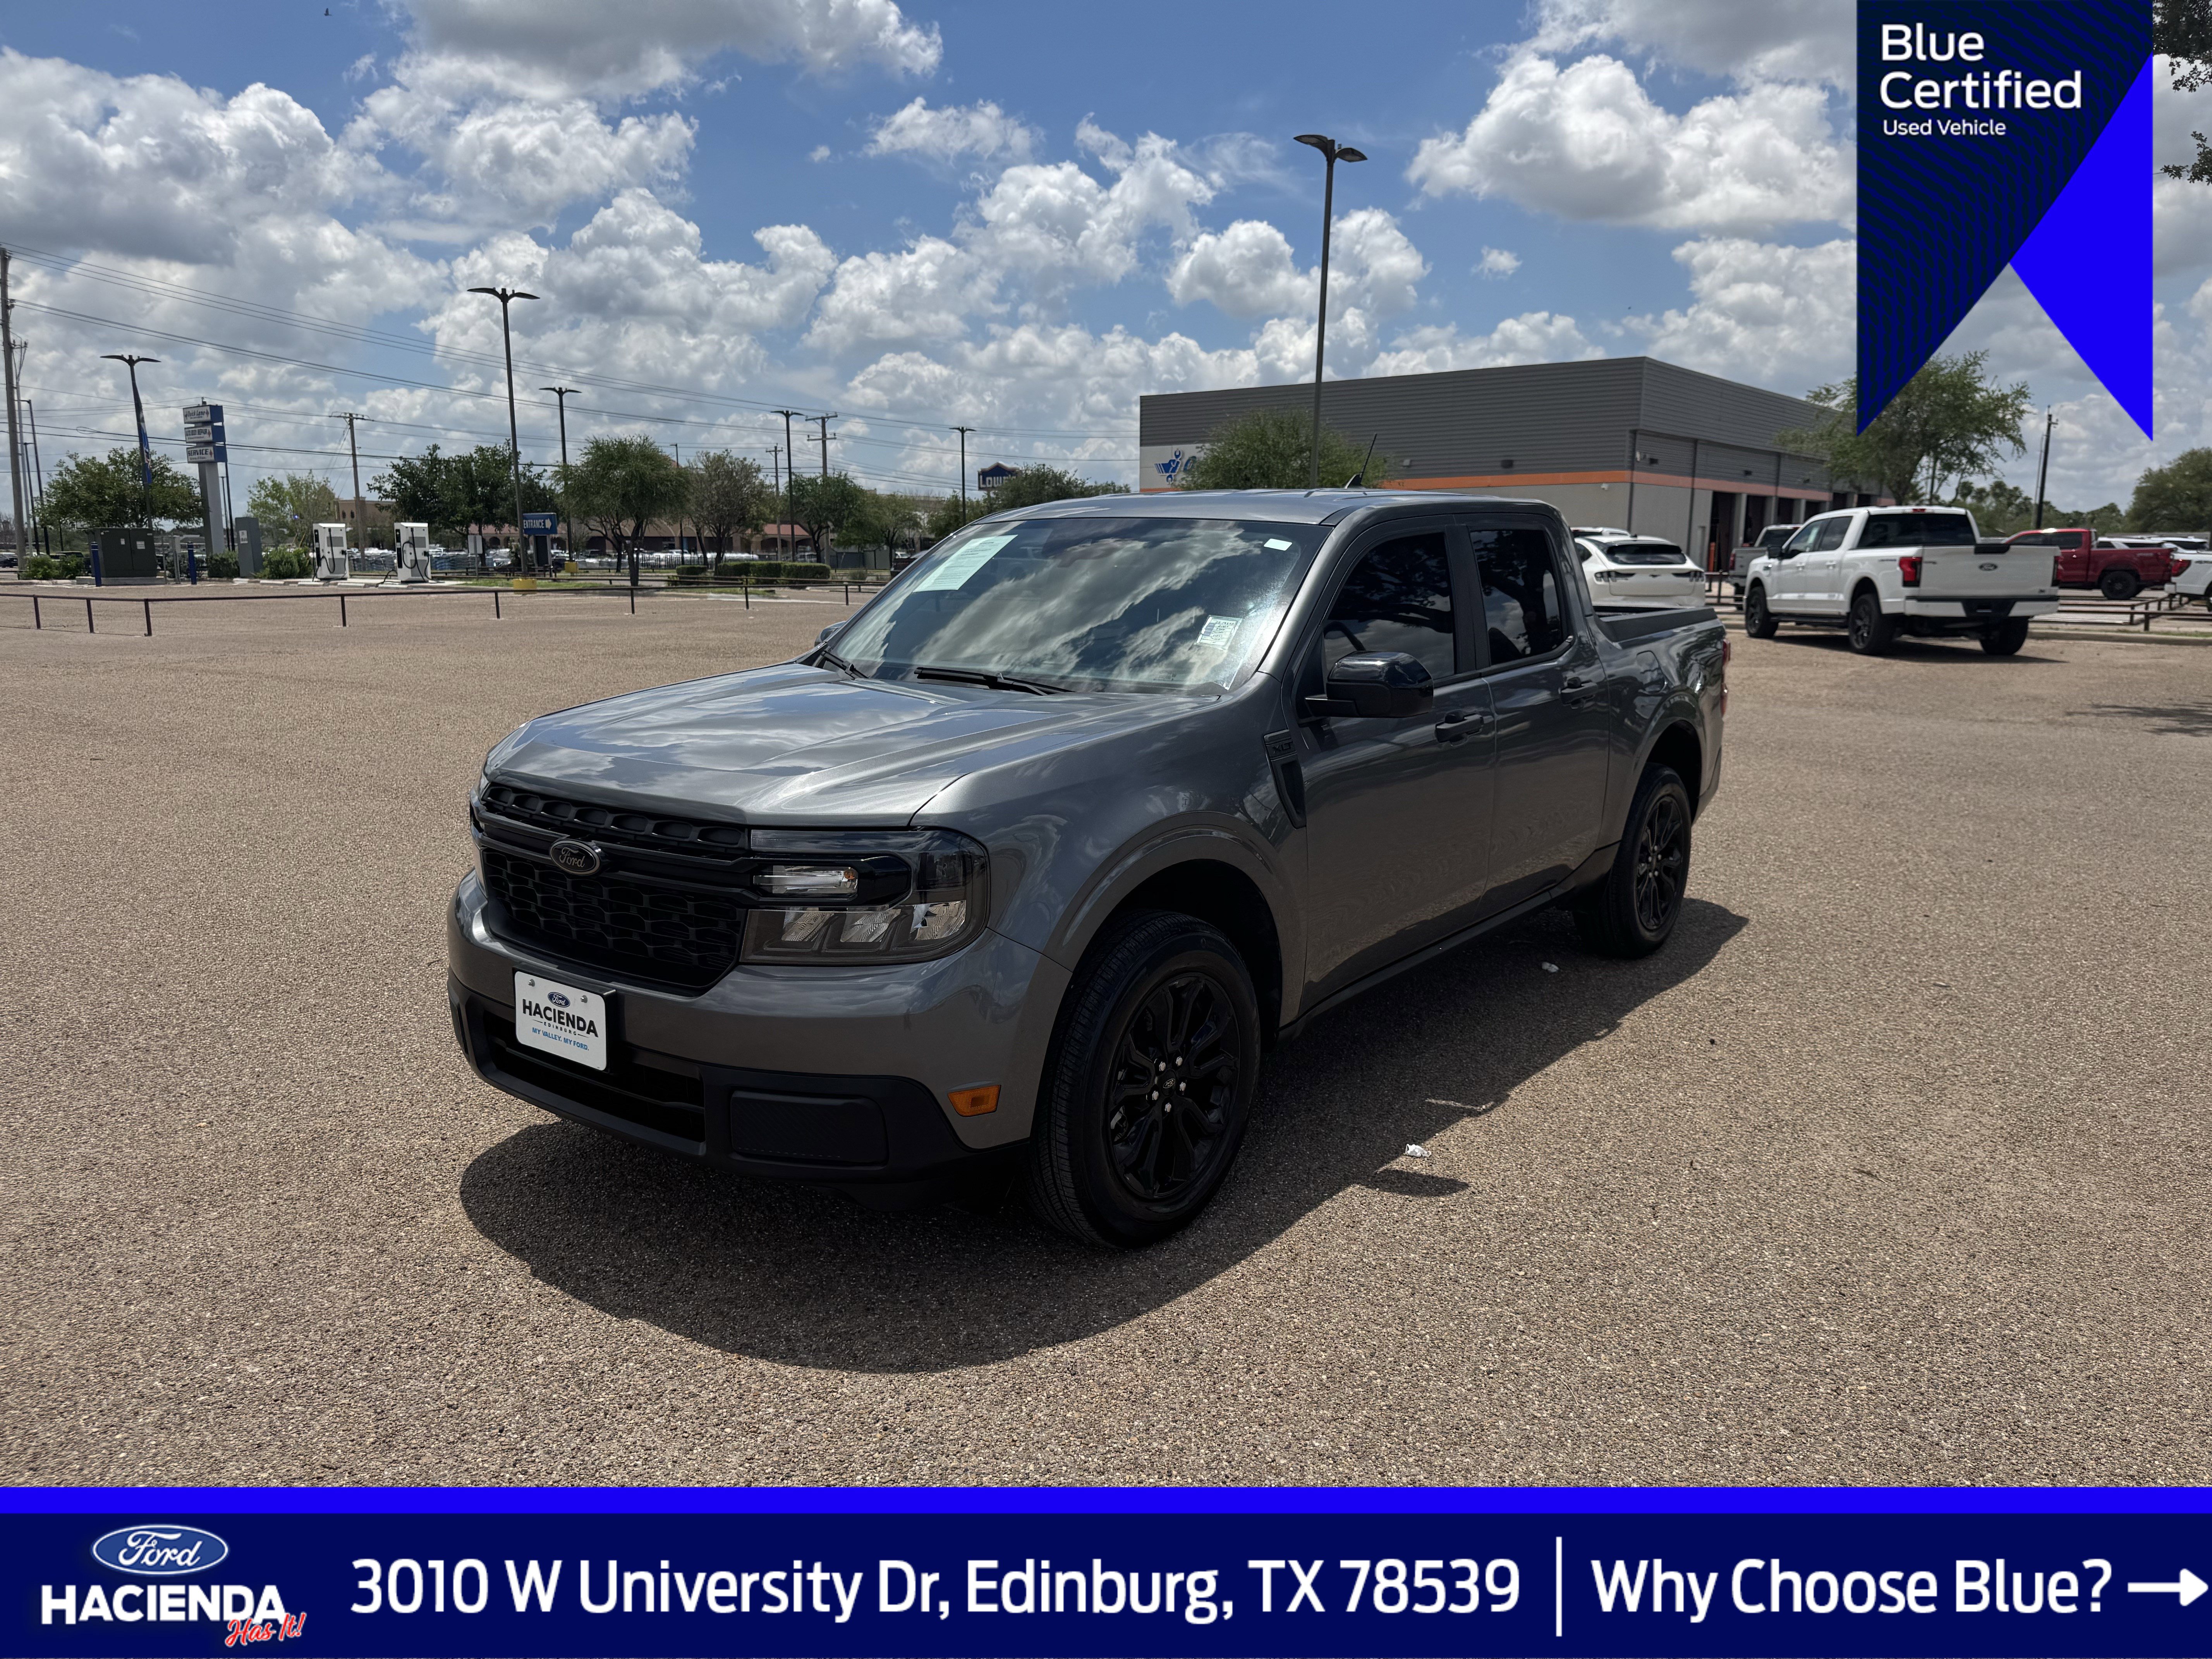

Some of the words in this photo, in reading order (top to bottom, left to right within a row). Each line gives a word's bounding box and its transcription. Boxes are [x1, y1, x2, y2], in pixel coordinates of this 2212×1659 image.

[188, 448, 209, 457] SERVICE
[523, 519, 544, 529] ENTRANCE
[1272, 741, 1293, 754] XLT
[559, 847, 586, 868] Ford
[552, 994, 566, 1005] Ford
[523, 998, 599, 1038] HACIENDA
[544, 1022, 577, 1036] EDINBURG
[573, 1041, 589, 1051] FORD.
